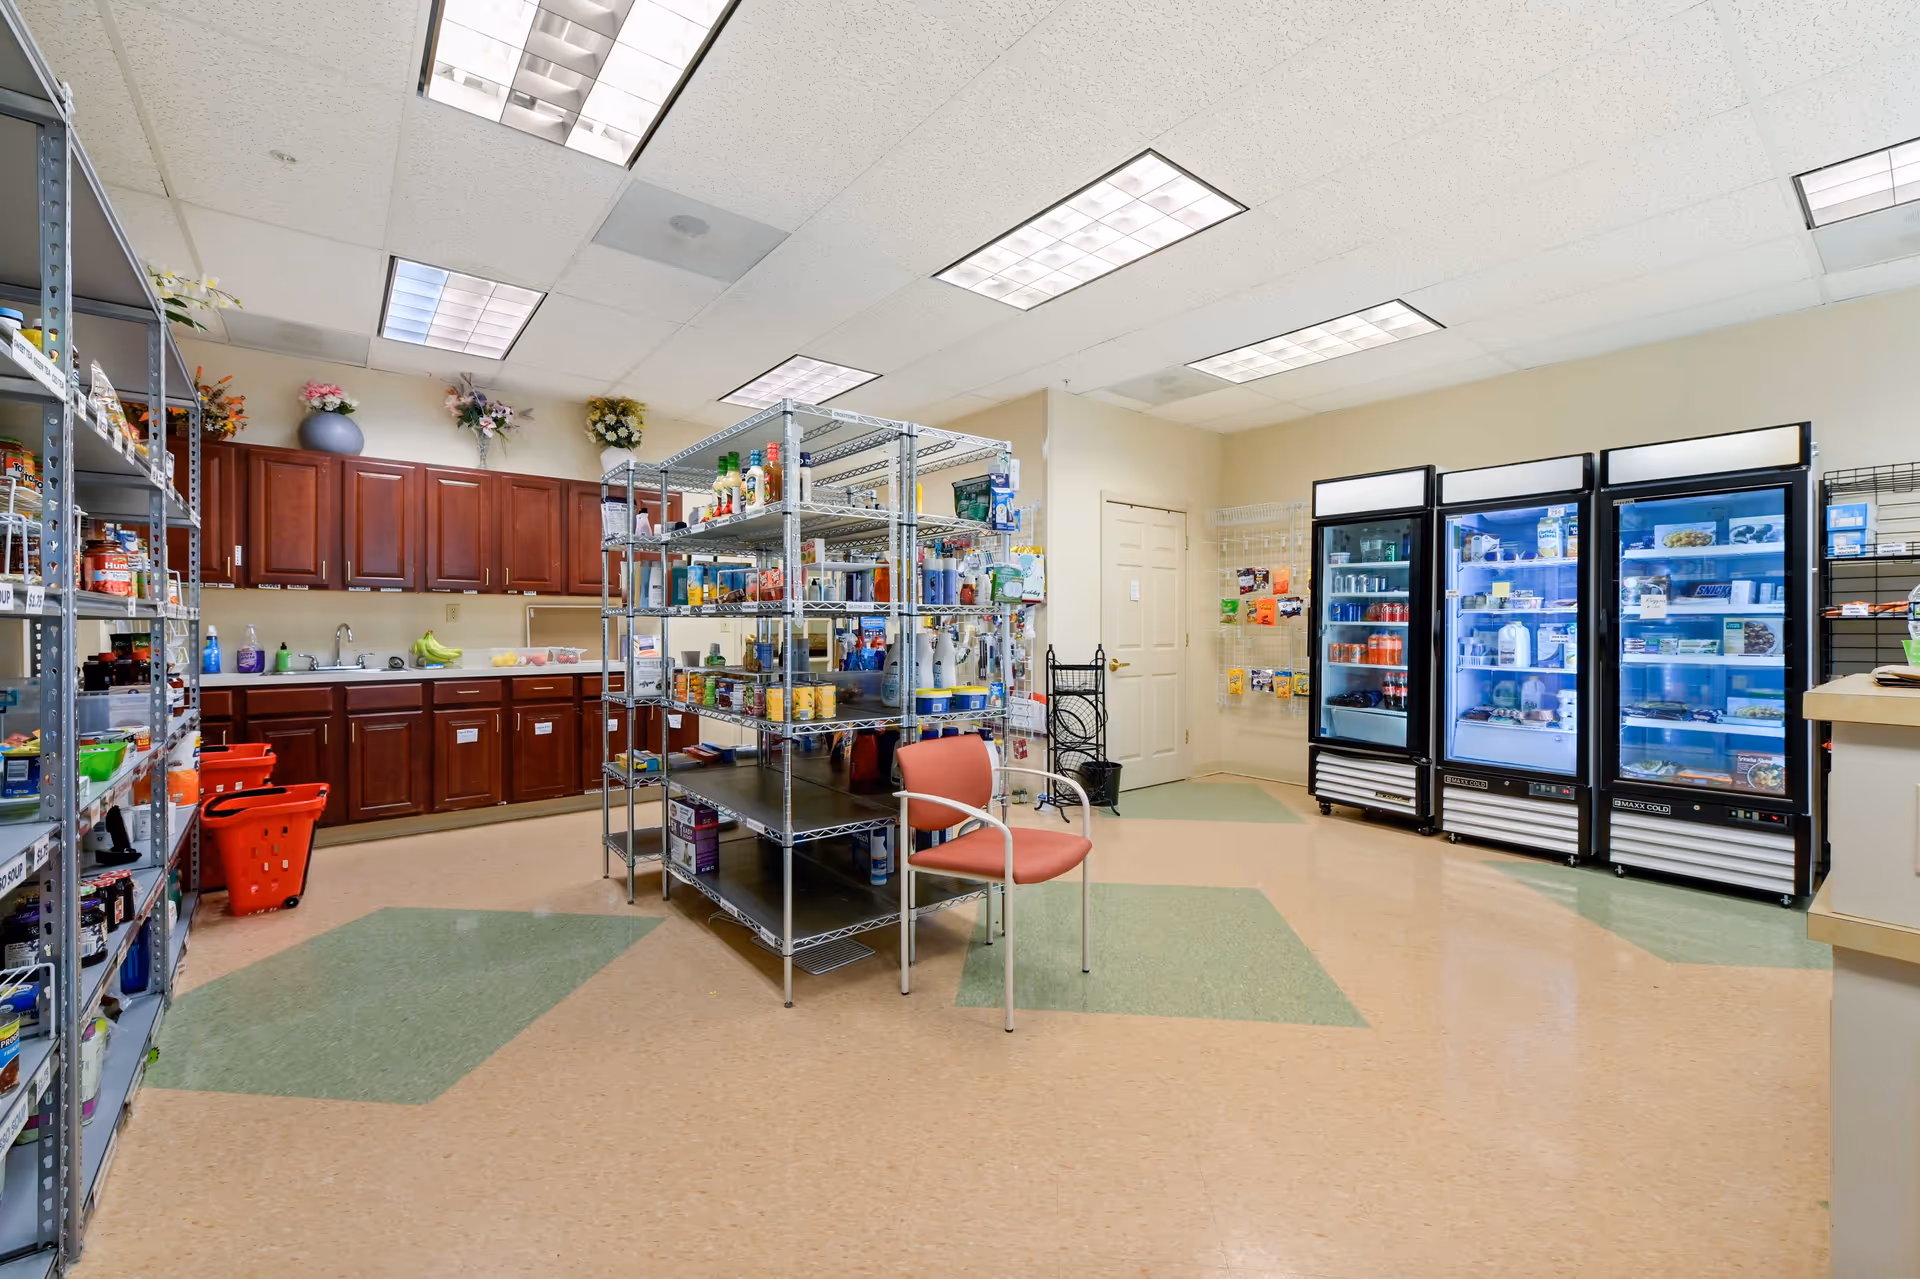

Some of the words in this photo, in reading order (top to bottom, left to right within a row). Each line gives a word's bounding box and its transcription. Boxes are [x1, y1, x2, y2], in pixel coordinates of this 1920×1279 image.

[833, 411, 857, 420] CROUTONS
[1696, 585, 1732, 596] SNICK
[1451, 778, 1469, 786] MAXX
[1469, 780, 1486, 788] COLD
[1621, 801, 1645, 810] MAXX
[1646, 804, 1669, 813] COLD
